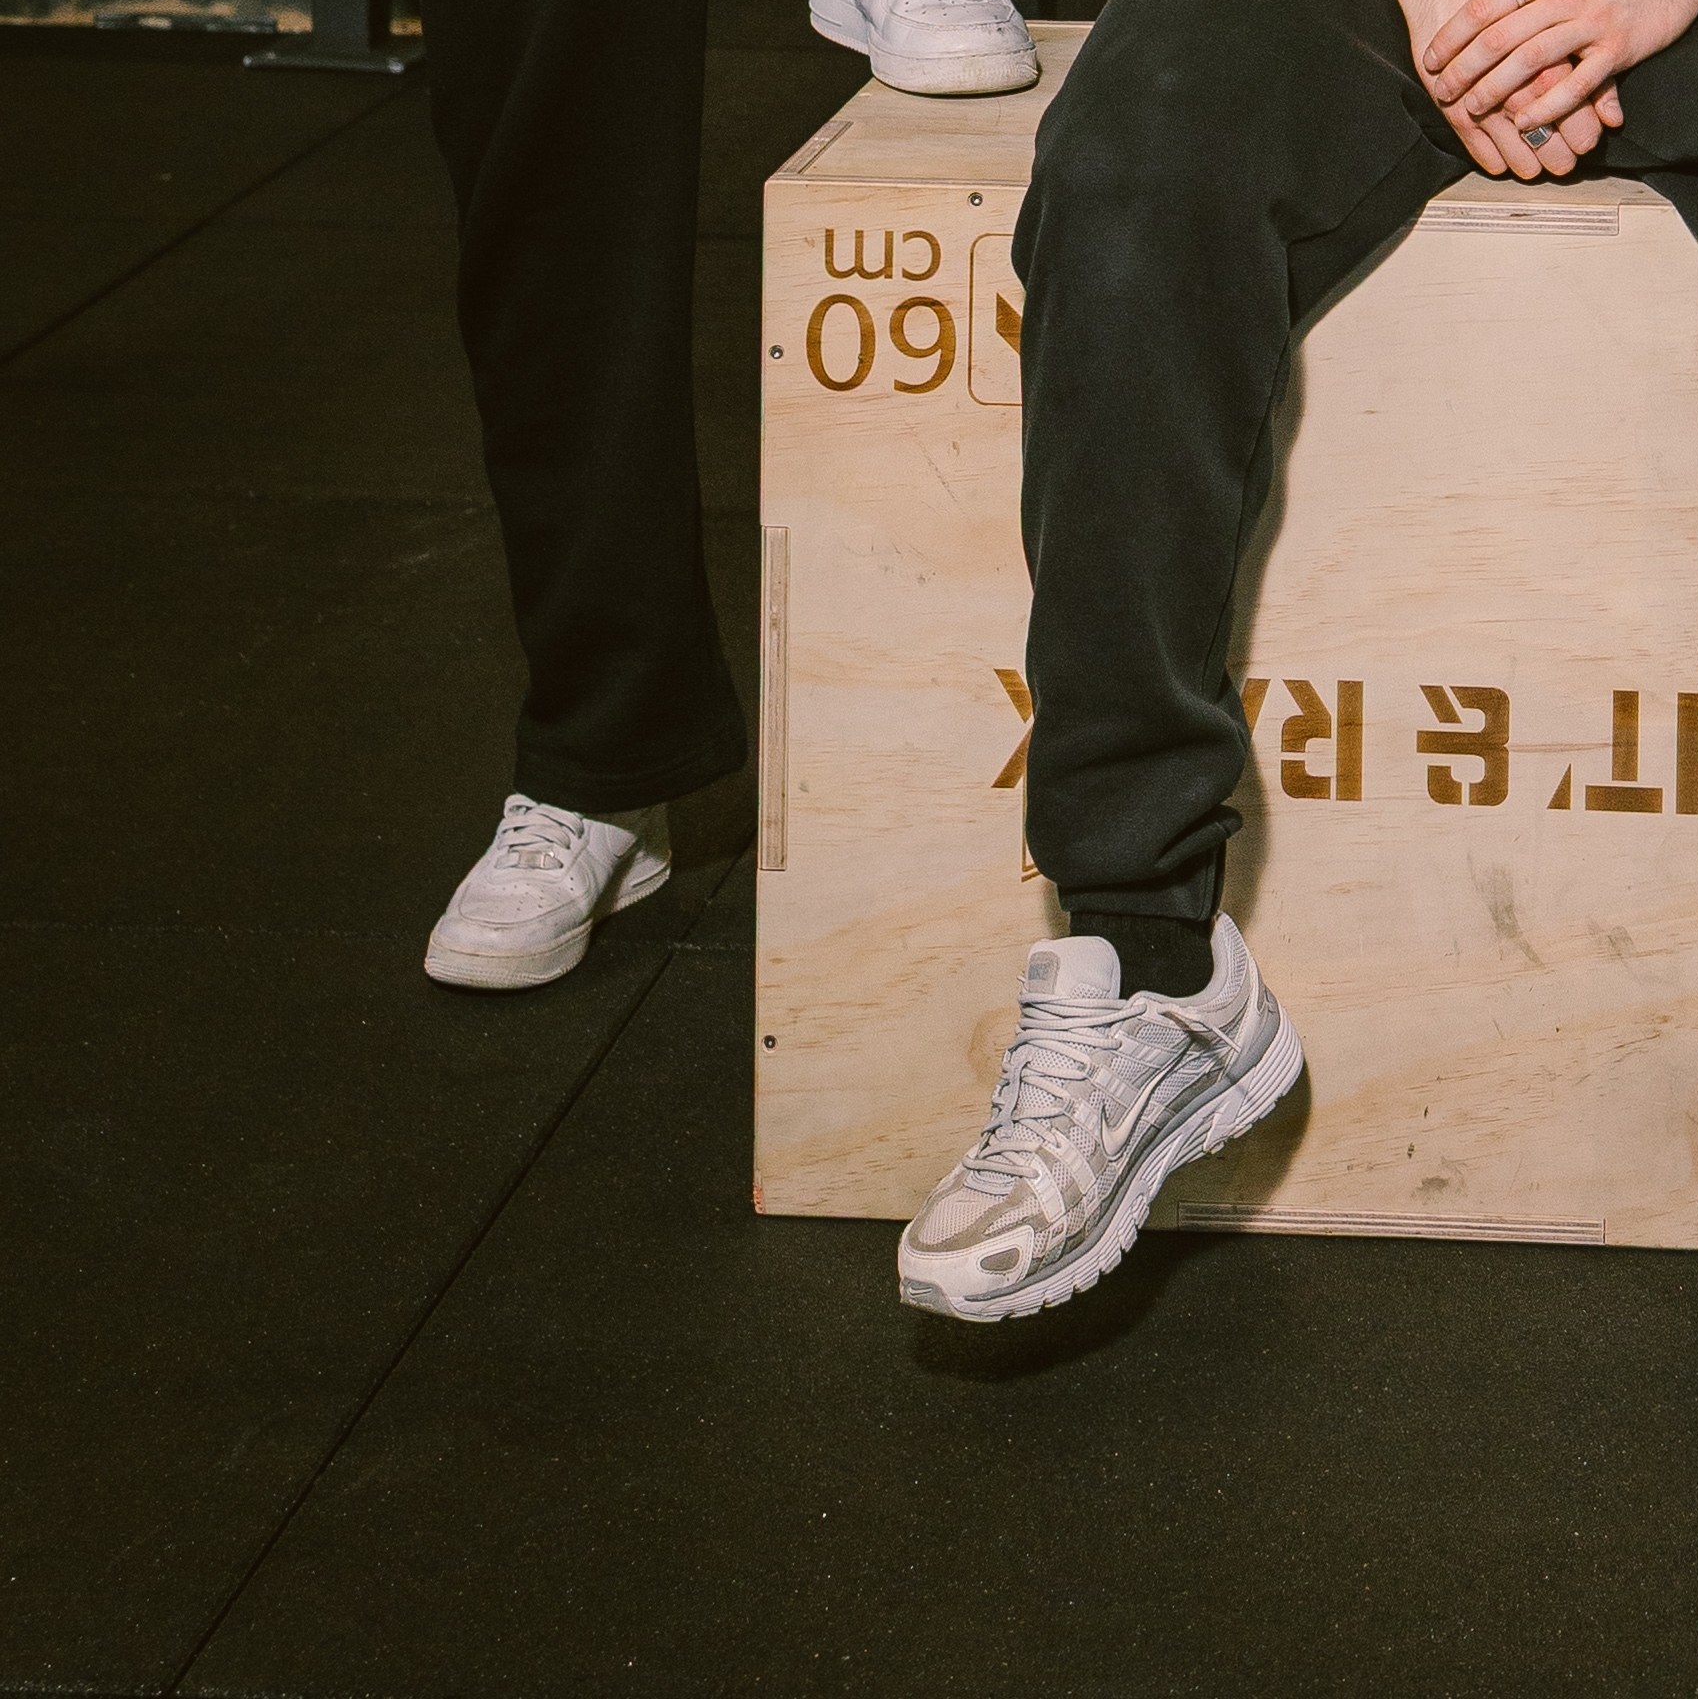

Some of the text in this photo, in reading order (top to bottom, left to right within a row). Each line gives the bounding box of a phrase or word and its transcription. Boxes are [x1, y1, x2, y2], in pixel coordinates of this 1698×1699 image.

[824, 228, 942, 281] cm
[806, 294, 957, 394] 60
[1417, 684, 1510, 807] &
